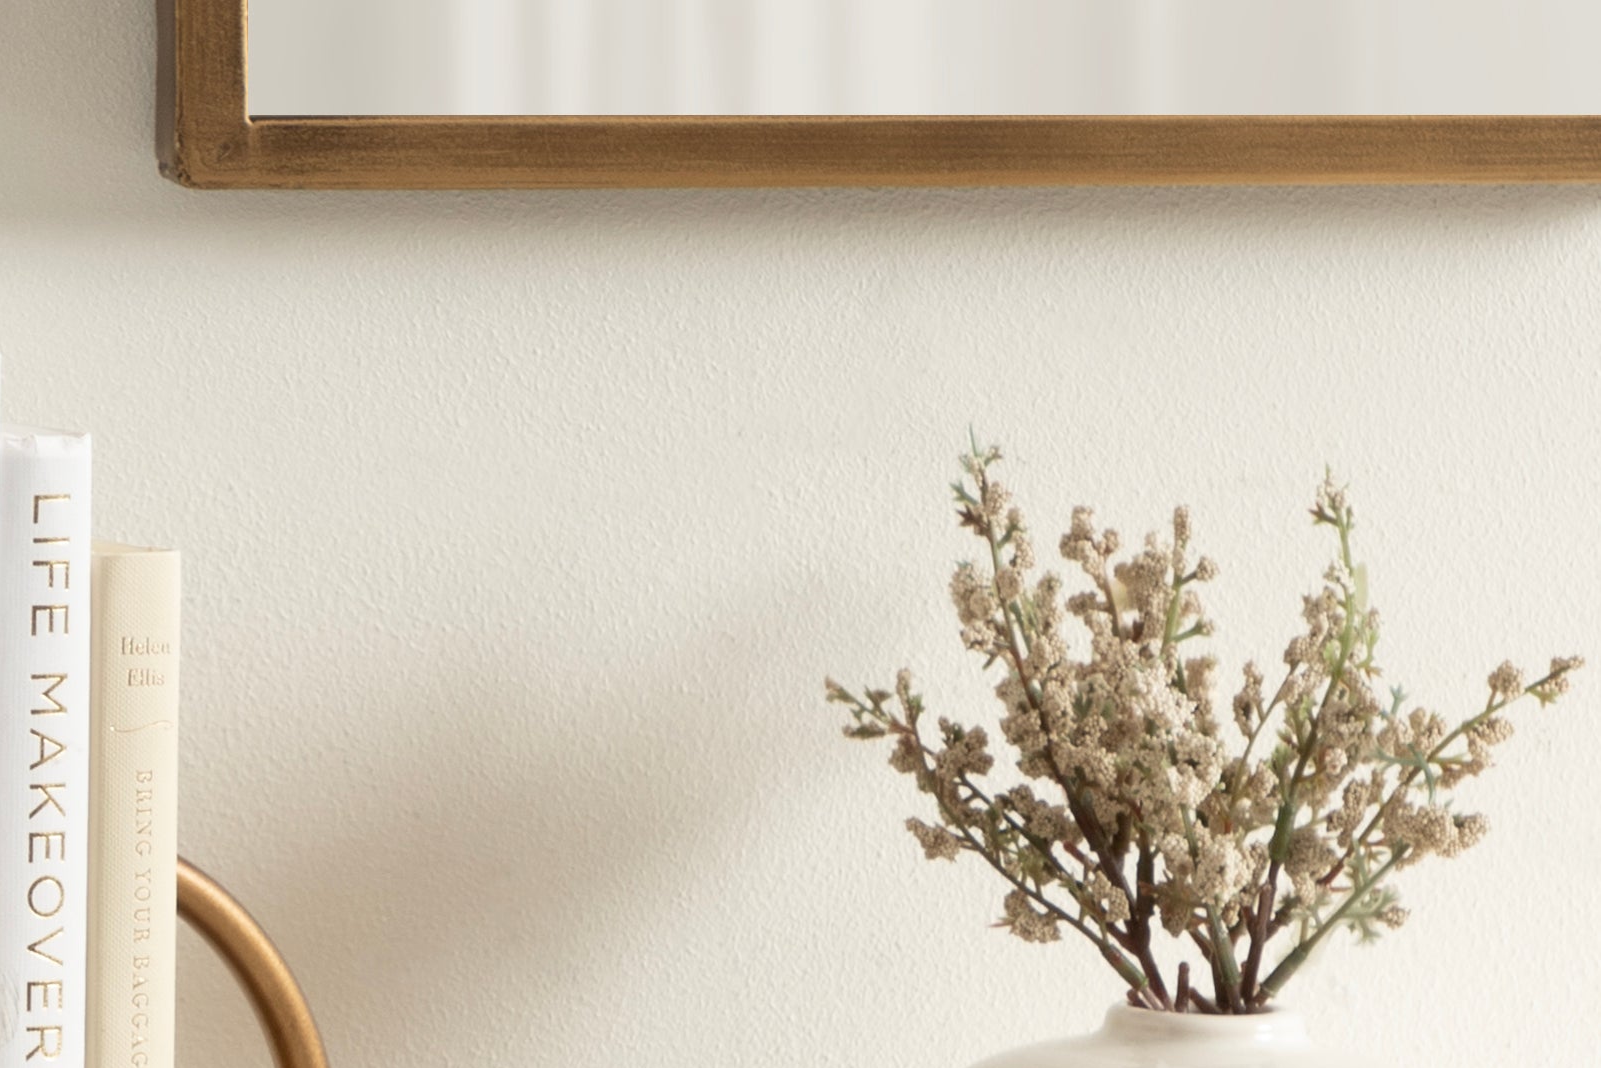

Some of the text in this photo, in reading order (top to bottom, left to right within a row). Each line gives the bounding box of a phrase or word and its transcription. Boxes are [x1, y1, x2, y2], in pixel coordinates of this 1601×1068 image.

[121, 636, 170, 655] Helen
[127, 668, 165, 686] Ellis
[24, 494, 71, 1063] LIFE MAKEOVER
[135, 769, 153, 858] BRING
[133, 868, 151, 944] YOUR
